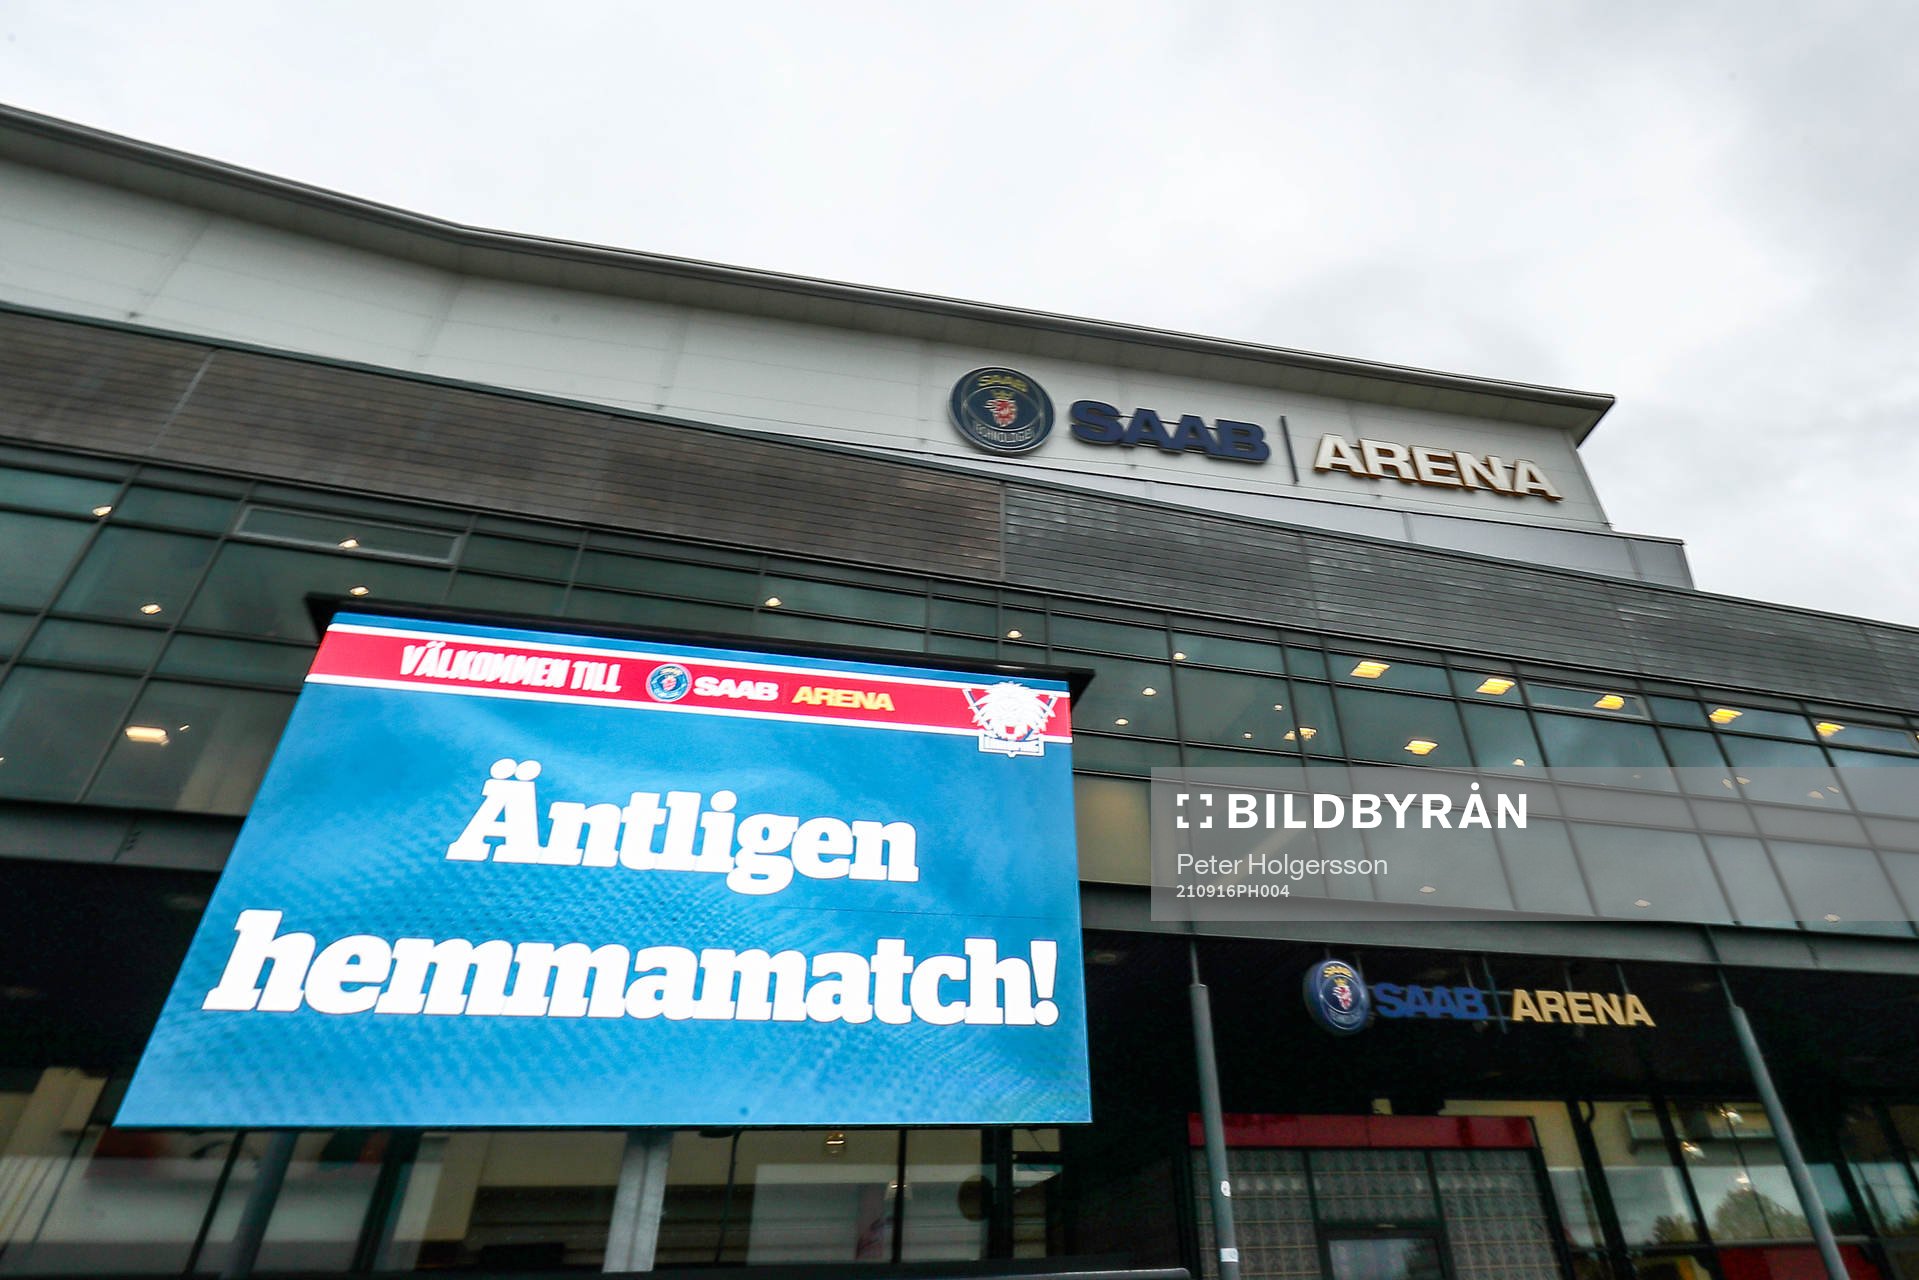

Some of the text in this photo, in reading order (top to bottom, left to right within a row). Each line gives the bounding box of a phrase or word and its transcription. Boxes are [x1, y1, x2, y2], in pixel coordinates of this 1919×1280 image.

[1070, 400, 1563, 501] SAAB ARENA
[400, 641, 895, 711] VÄLKOMMEN TILL SAAB ARENA
[445, 758, 920, 895] Äntligen
[202, 909, 1059, 1026] hemmamatch!
[1373, 983, 1488, 1020] SAAB
[1512, 988, 1656, 1027] ARENA
